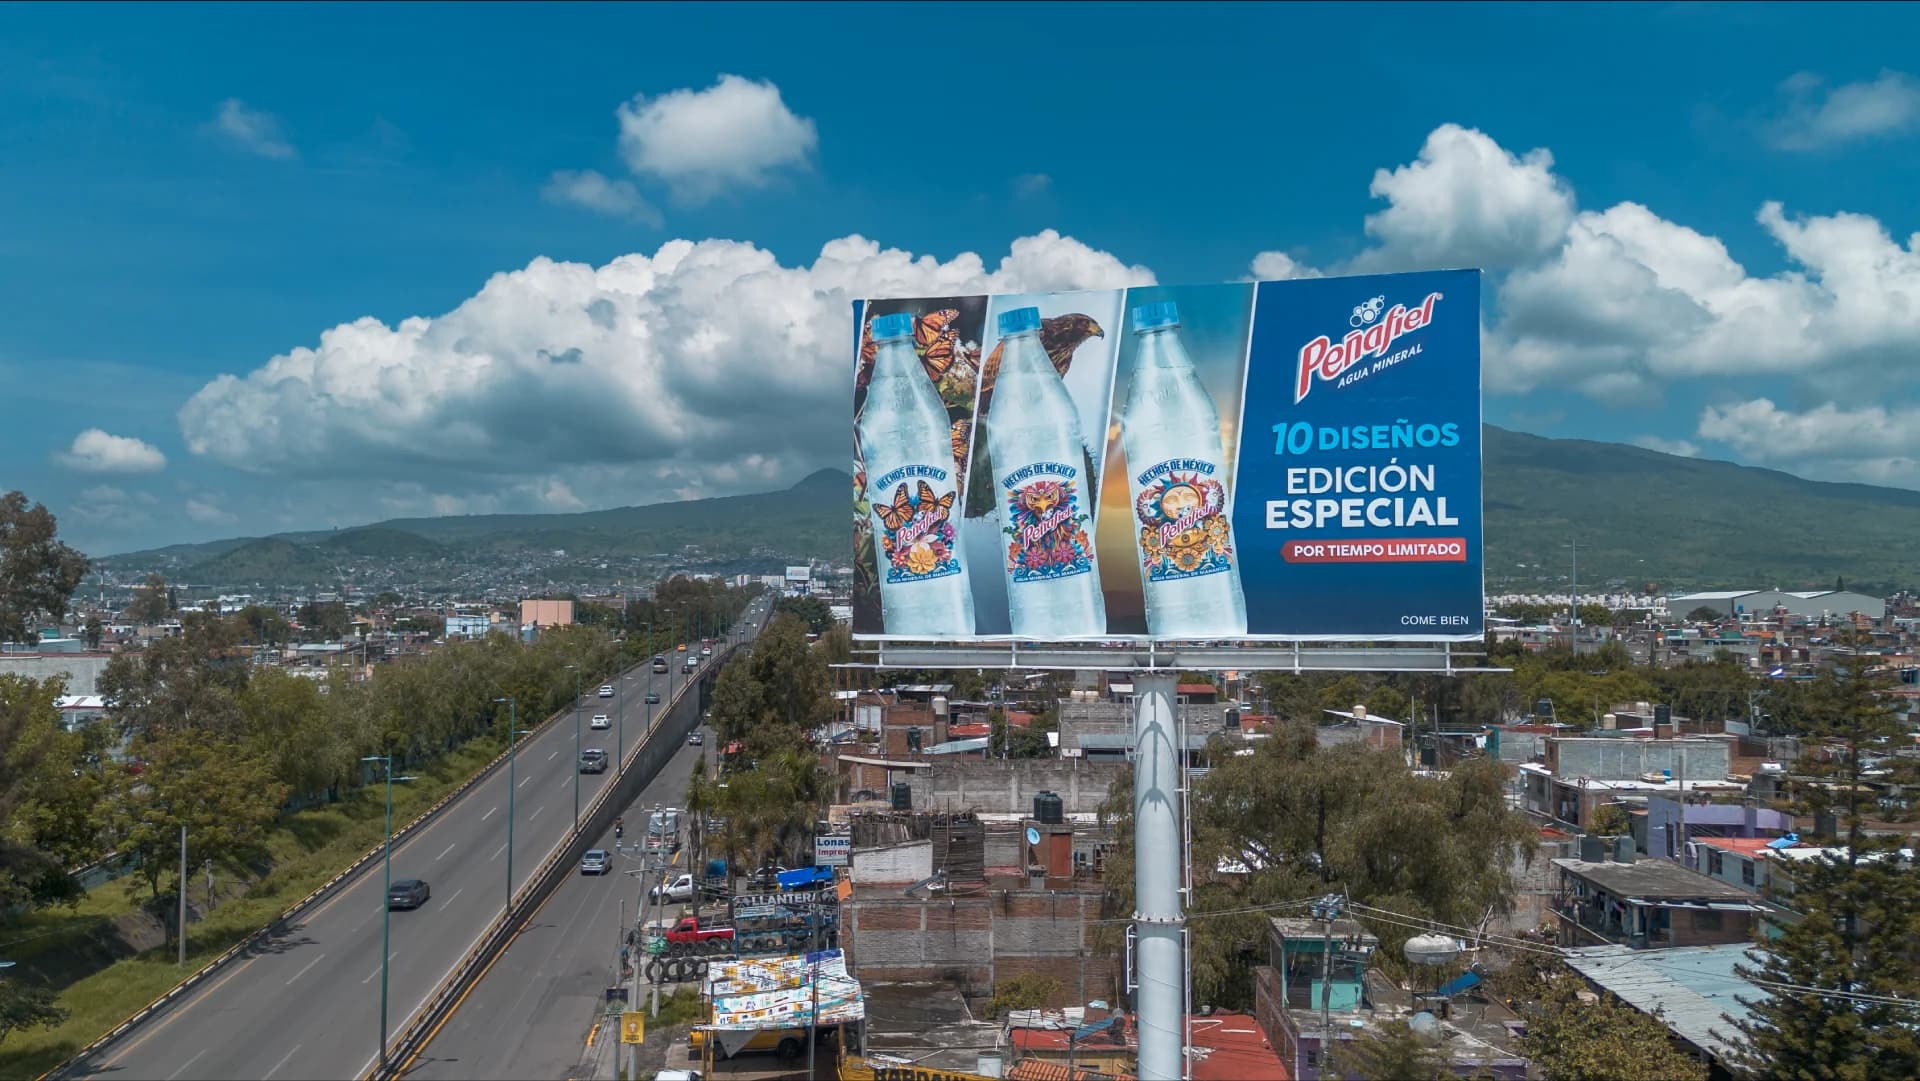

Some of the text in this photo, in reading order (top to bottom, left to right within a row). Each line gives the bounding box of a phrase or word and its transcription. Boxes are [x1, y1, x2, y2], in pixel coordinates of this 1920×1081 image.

[1295, 292, 1438, 404] Peñafiel
[1337, 343, 1423, 389] AGUA MINERAL
[1272, 418, 1460, 455] 10 DISEÑOS
[876, 465, 946, 490] HECHOS DE MÉXICO
[1003, 462, 1076, 489] HECHOS DE MÉXICO
[1138, 458, 1214, 486] HECHOS DE MÉXICO
[1287, 457, 1435, 494] EDICIÓN
[1266, 497, 1459, 529] ESPECIAL
[1294, 543, 1460, 557] POR TIEMPO LIMITADO
[1401, 616, 1469, 625] COME BIEN
[817, 838, 849, 846] Lonas
